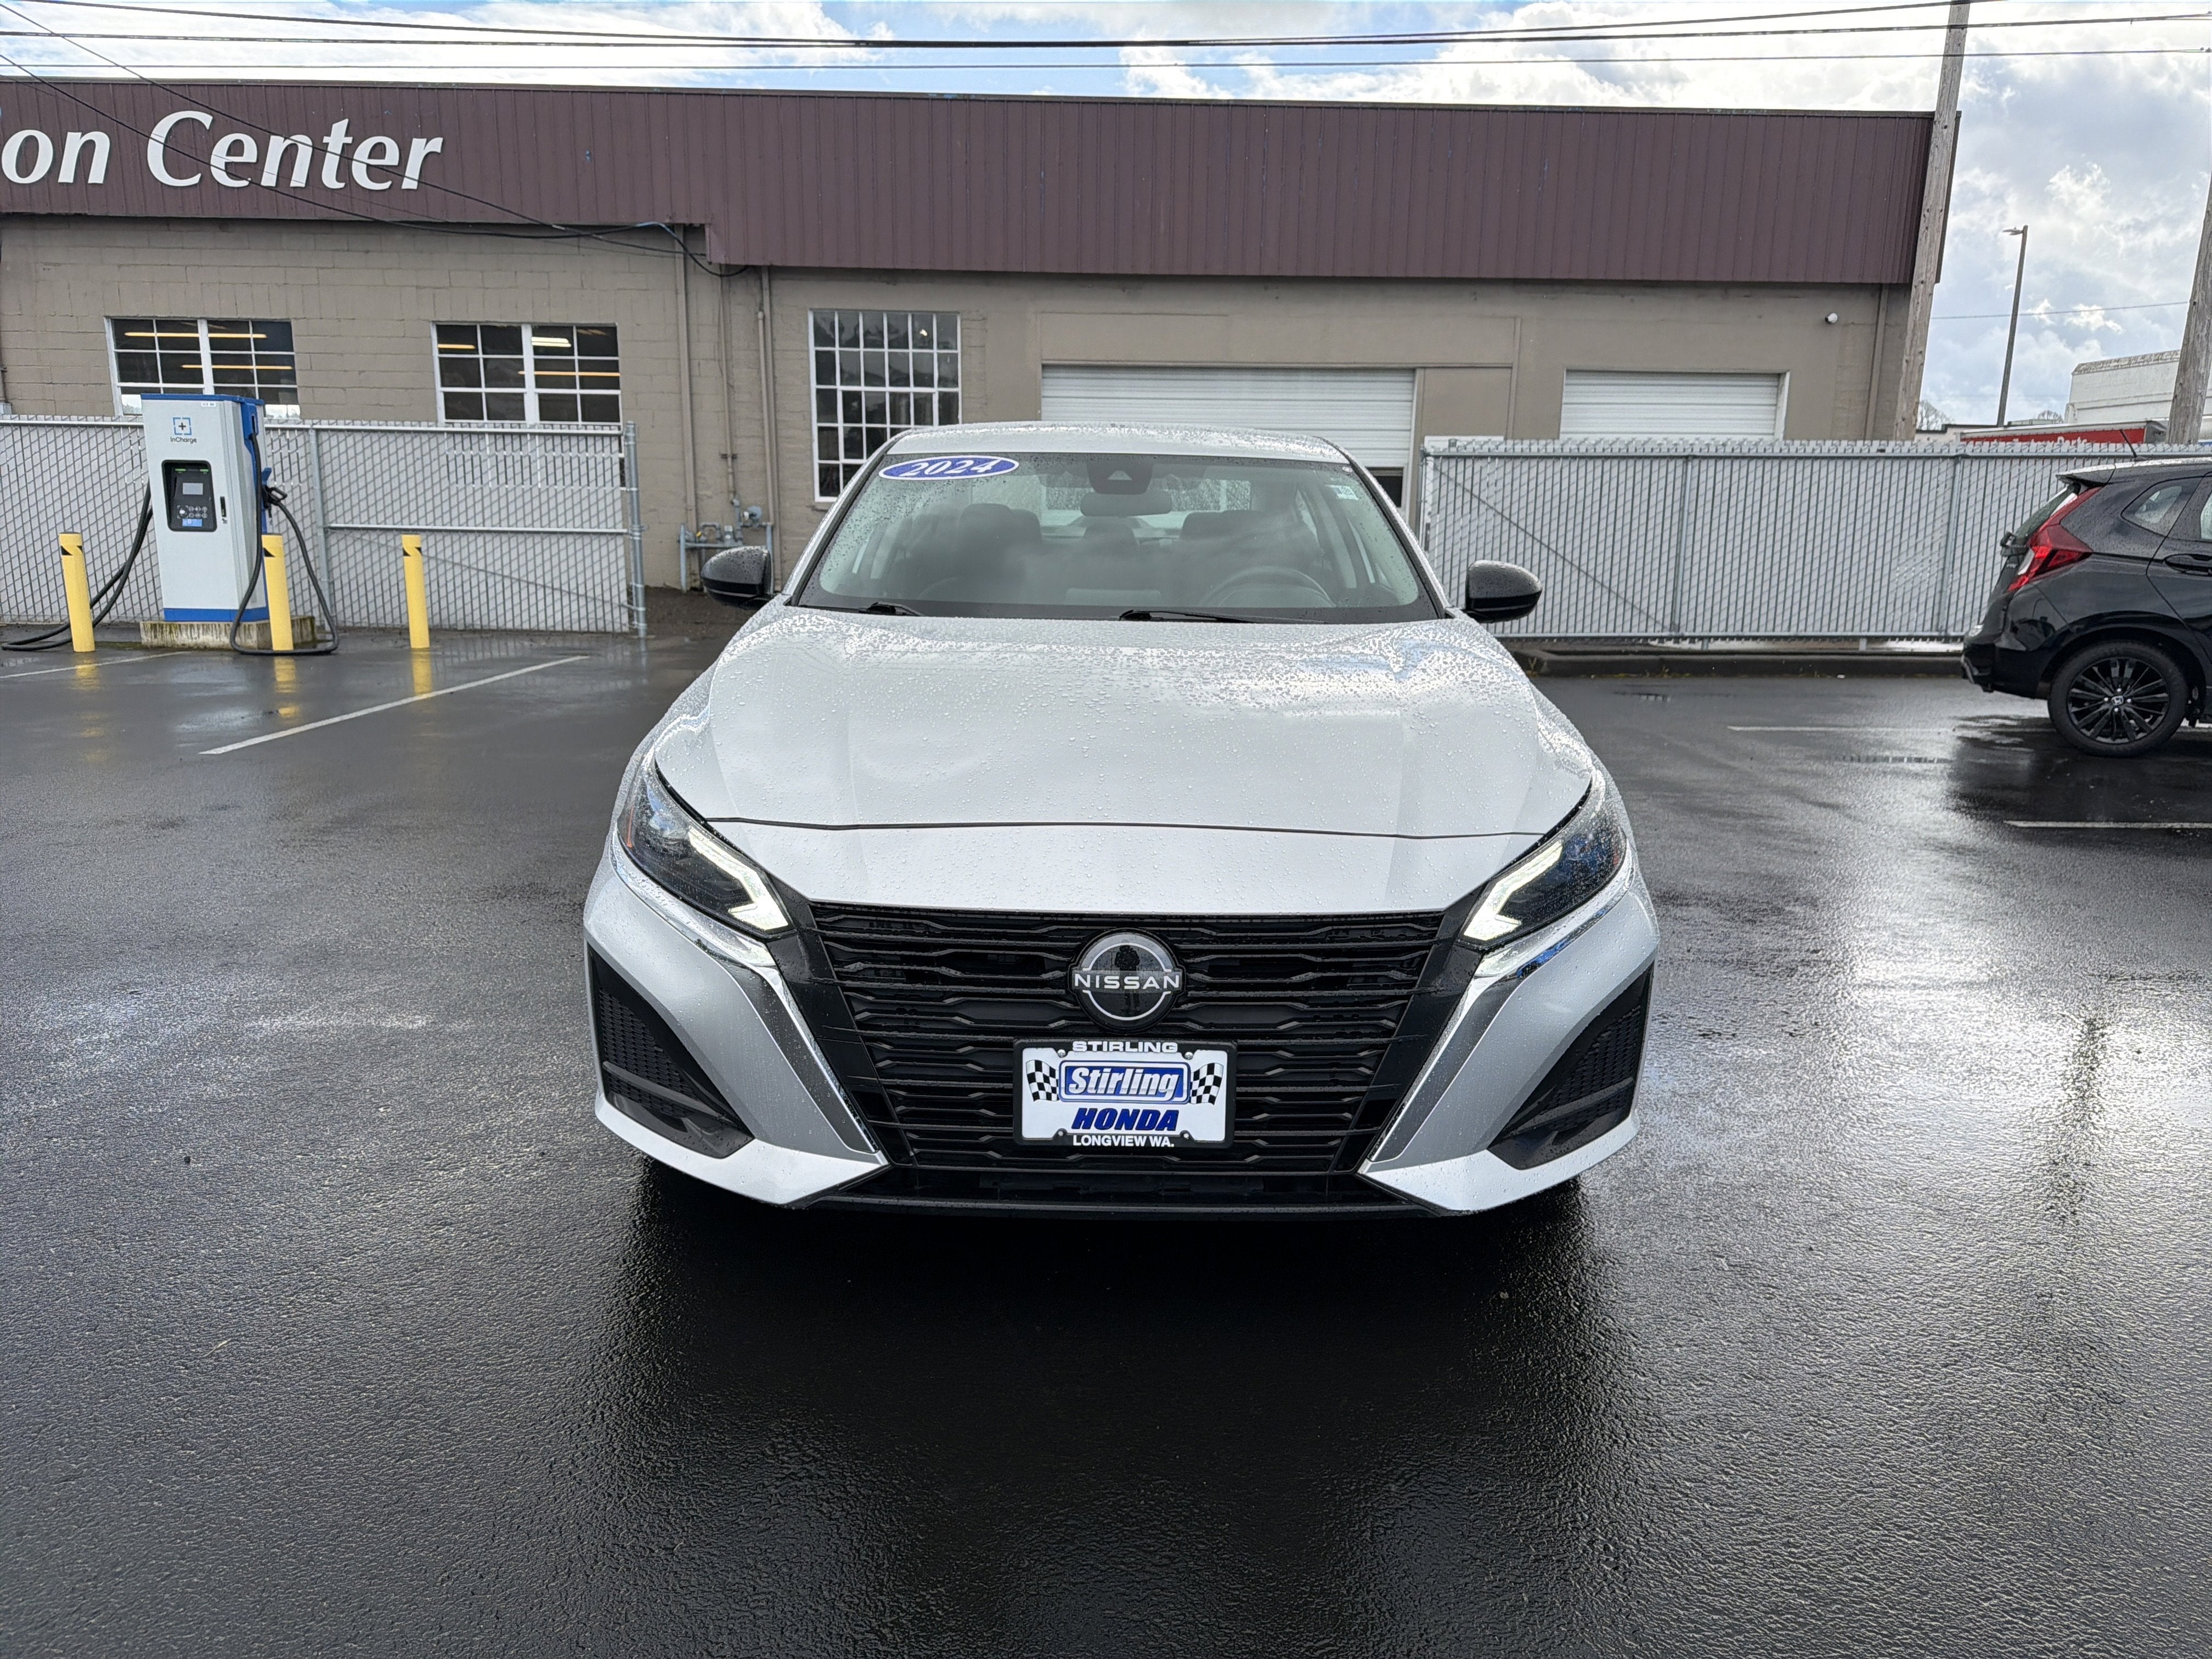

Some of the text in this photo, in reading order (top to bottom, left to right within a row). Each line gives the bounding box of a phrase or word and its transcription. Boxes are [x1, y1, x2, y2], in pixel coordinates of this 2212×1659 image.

[1, 110, 443, 190] on Center
[899, 459, 1002, 476] 2024
[1074, 973, 1180, 990] NISSAN
[1072, 1040, 1178, 1053] STIRLING
[1068, 1066, 1180, 1101] Stirling
[1071, 1107, 1180, 1132] HONDA
[1073, 1135, 1175, 1147] LONGVIEW WA.
